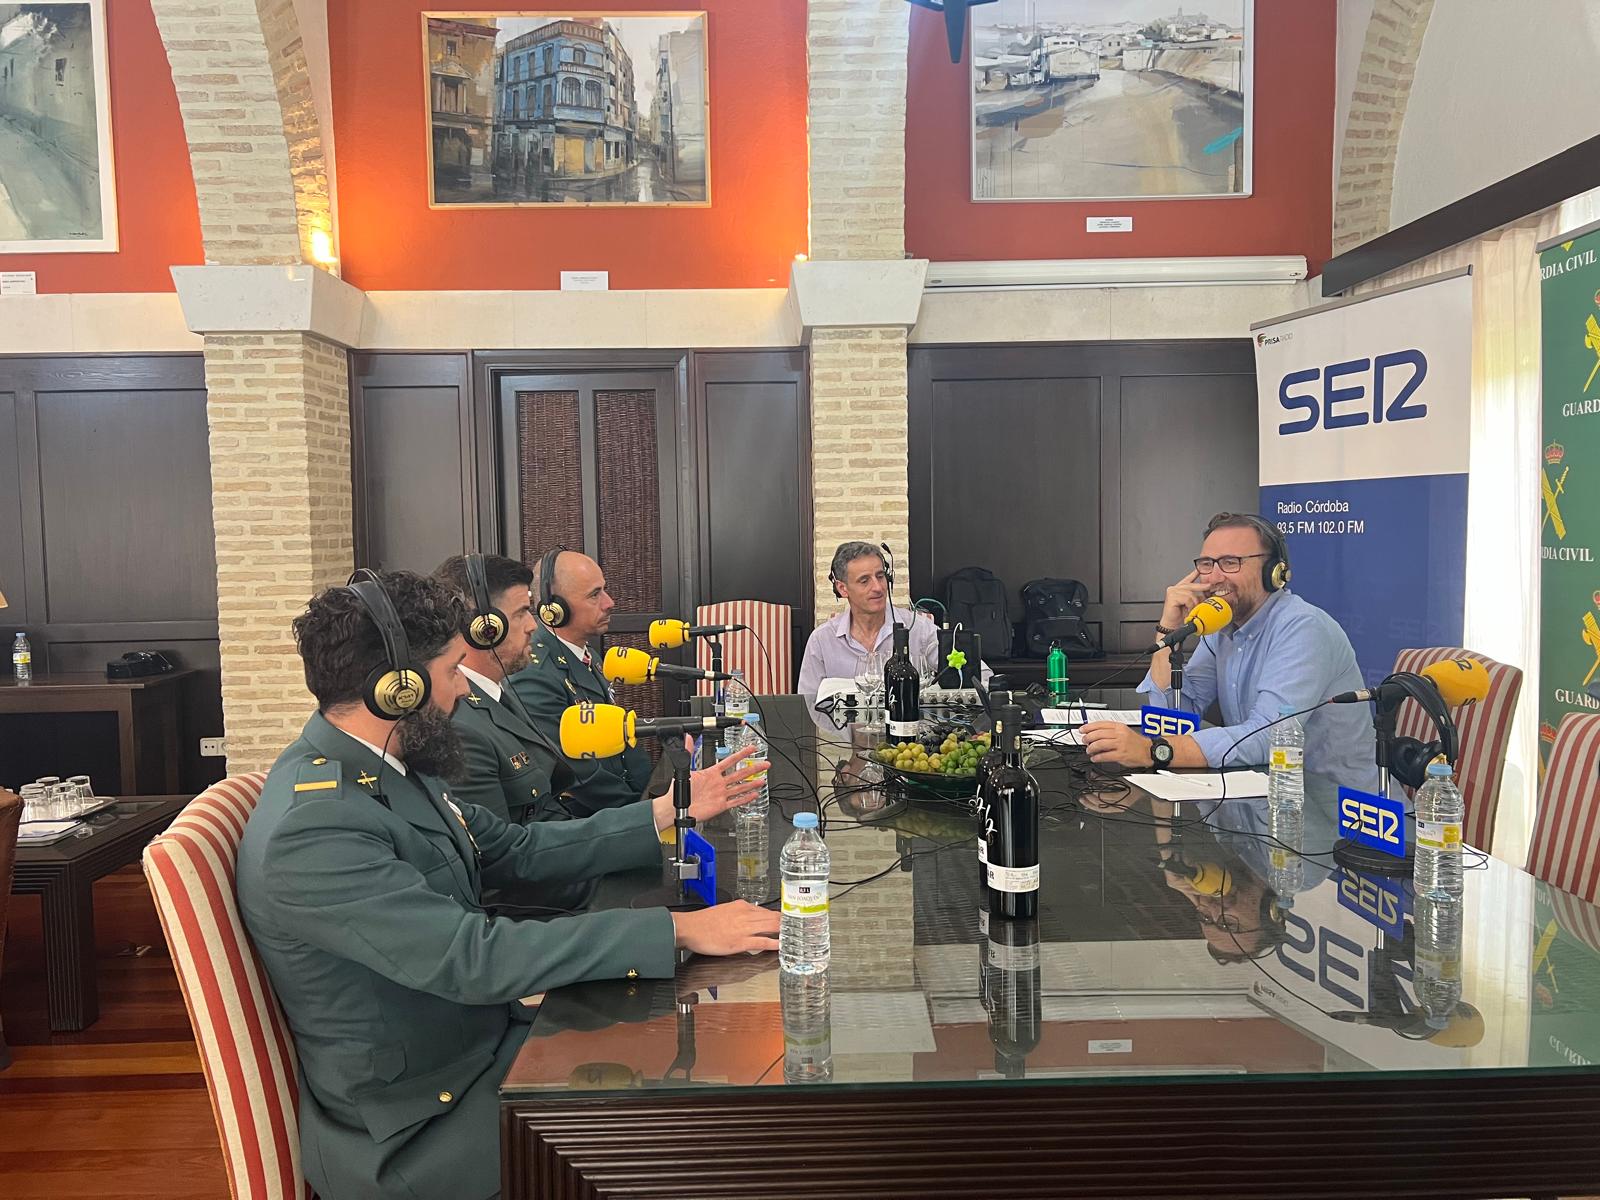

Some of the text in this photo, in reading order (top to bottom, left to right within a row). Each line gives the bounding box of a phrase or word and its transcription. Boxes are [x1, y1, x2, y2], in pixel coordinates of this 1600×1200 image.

[1566, 249, 1598, 271] CIVIL
[1278, 349, 1428, 436] SER
[1277, 500, 1349, 514] Radio Córdoba
[1277, 520, 1364, 534] 93.5 FM 102.0 FM
[1559, 547, 1594, 562] CIVIL
[1341, 798, 1400, 845] SER
